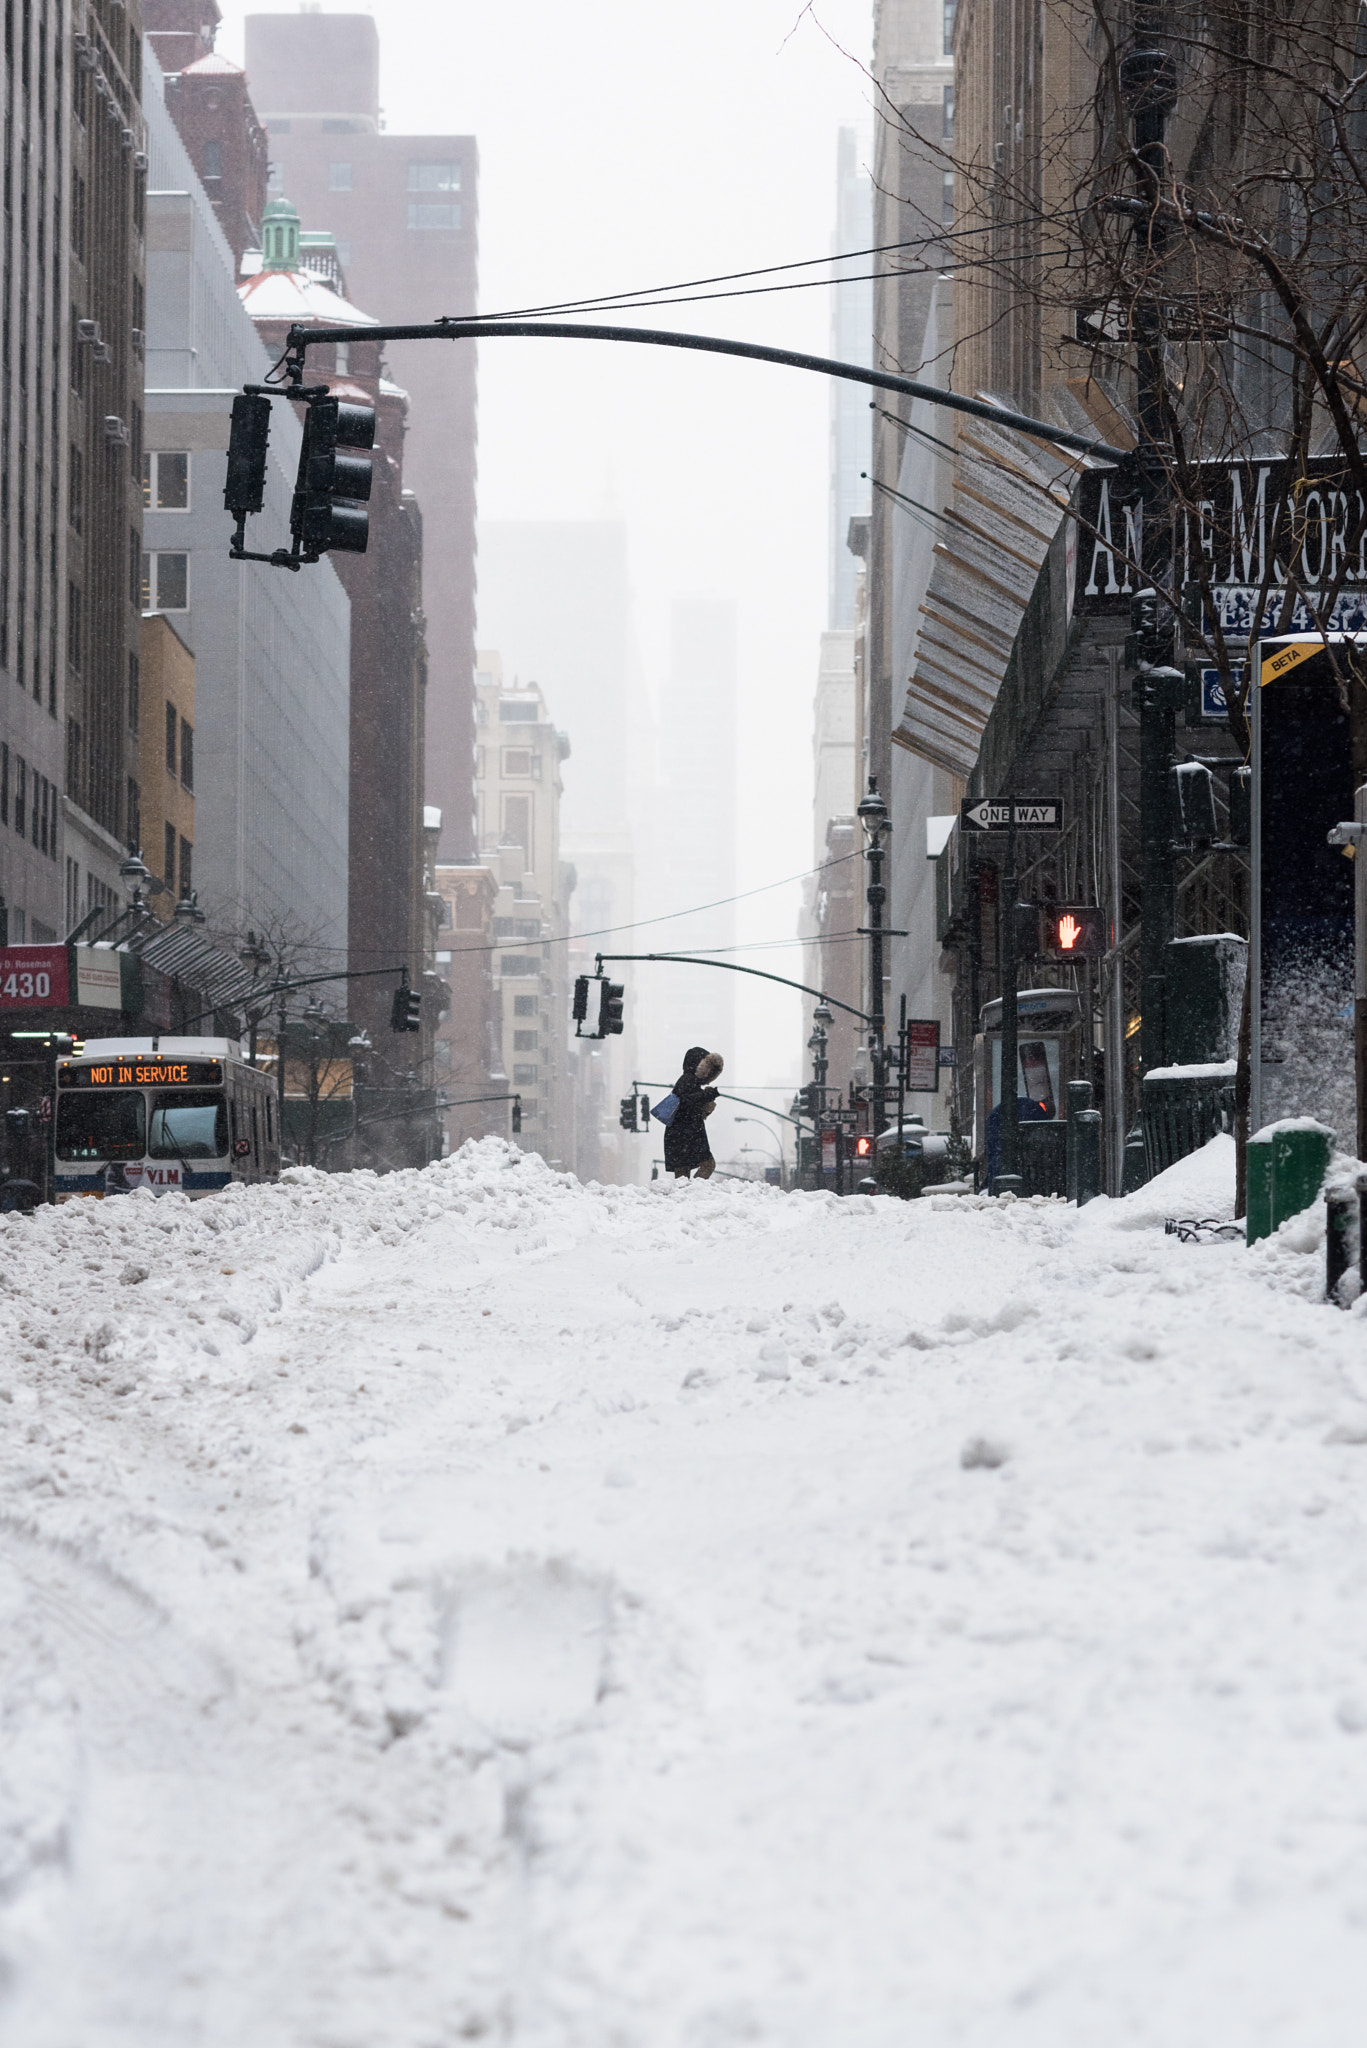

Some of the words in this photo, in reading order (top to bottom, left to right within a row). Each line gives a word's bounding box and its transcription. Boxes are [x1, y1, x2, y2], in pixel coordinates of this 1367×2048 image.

[1085, 479, 1216, 595] ANIE
[1271, 650, 1301, 671] BETA
[980, 808, 1010, 821] ONE
[1018, 808, 1049, 821] WAY
[16, 961, 51, 969] Roseman
[0, 972, 50, 998] 430
[91, 1067, 113, 1083] NOT
[118, 1067, 132, 1083] IN
[136, 1065, 188, 1082] SERVICE
